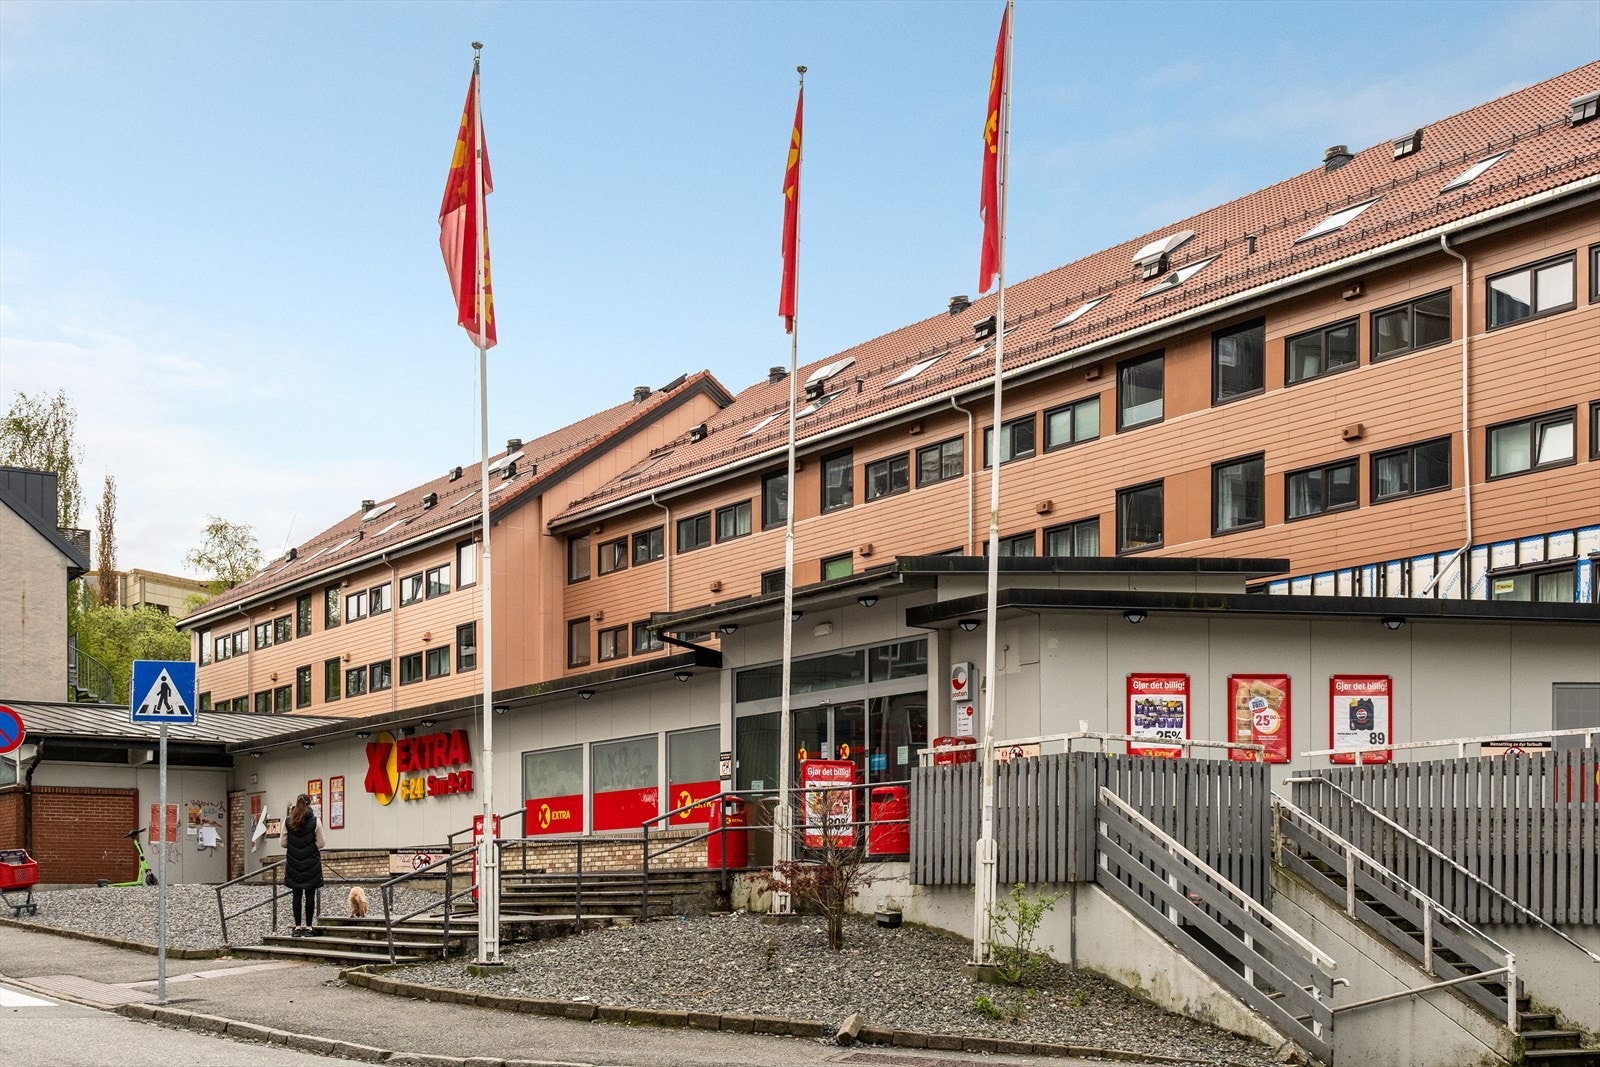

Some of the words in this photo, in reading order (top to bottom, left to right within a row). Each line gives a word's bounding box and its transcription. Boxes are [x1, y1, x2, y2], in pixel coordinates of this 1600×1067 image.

[1132, 681, 1148, 690] Gjør
[1150, 681, 1163, 689] det
[1164, 681, 1185, 690] billig!
[1336, 682, 1351, 691] Gjør
[1353, 682, 1365, 690] det
[1367, 682, 1387, 691] billig!
[1369, 732, 1385, 745] 89
[397, 729, 471, 773] EXTRA
[807, 767, 821, 777] Gjør
[822, 768, 833, 776] det
[833, 768, 851, 778] billig!
[401, 777, 425, 801] 6-24
[551, 810, 571, 820] EXTRA
